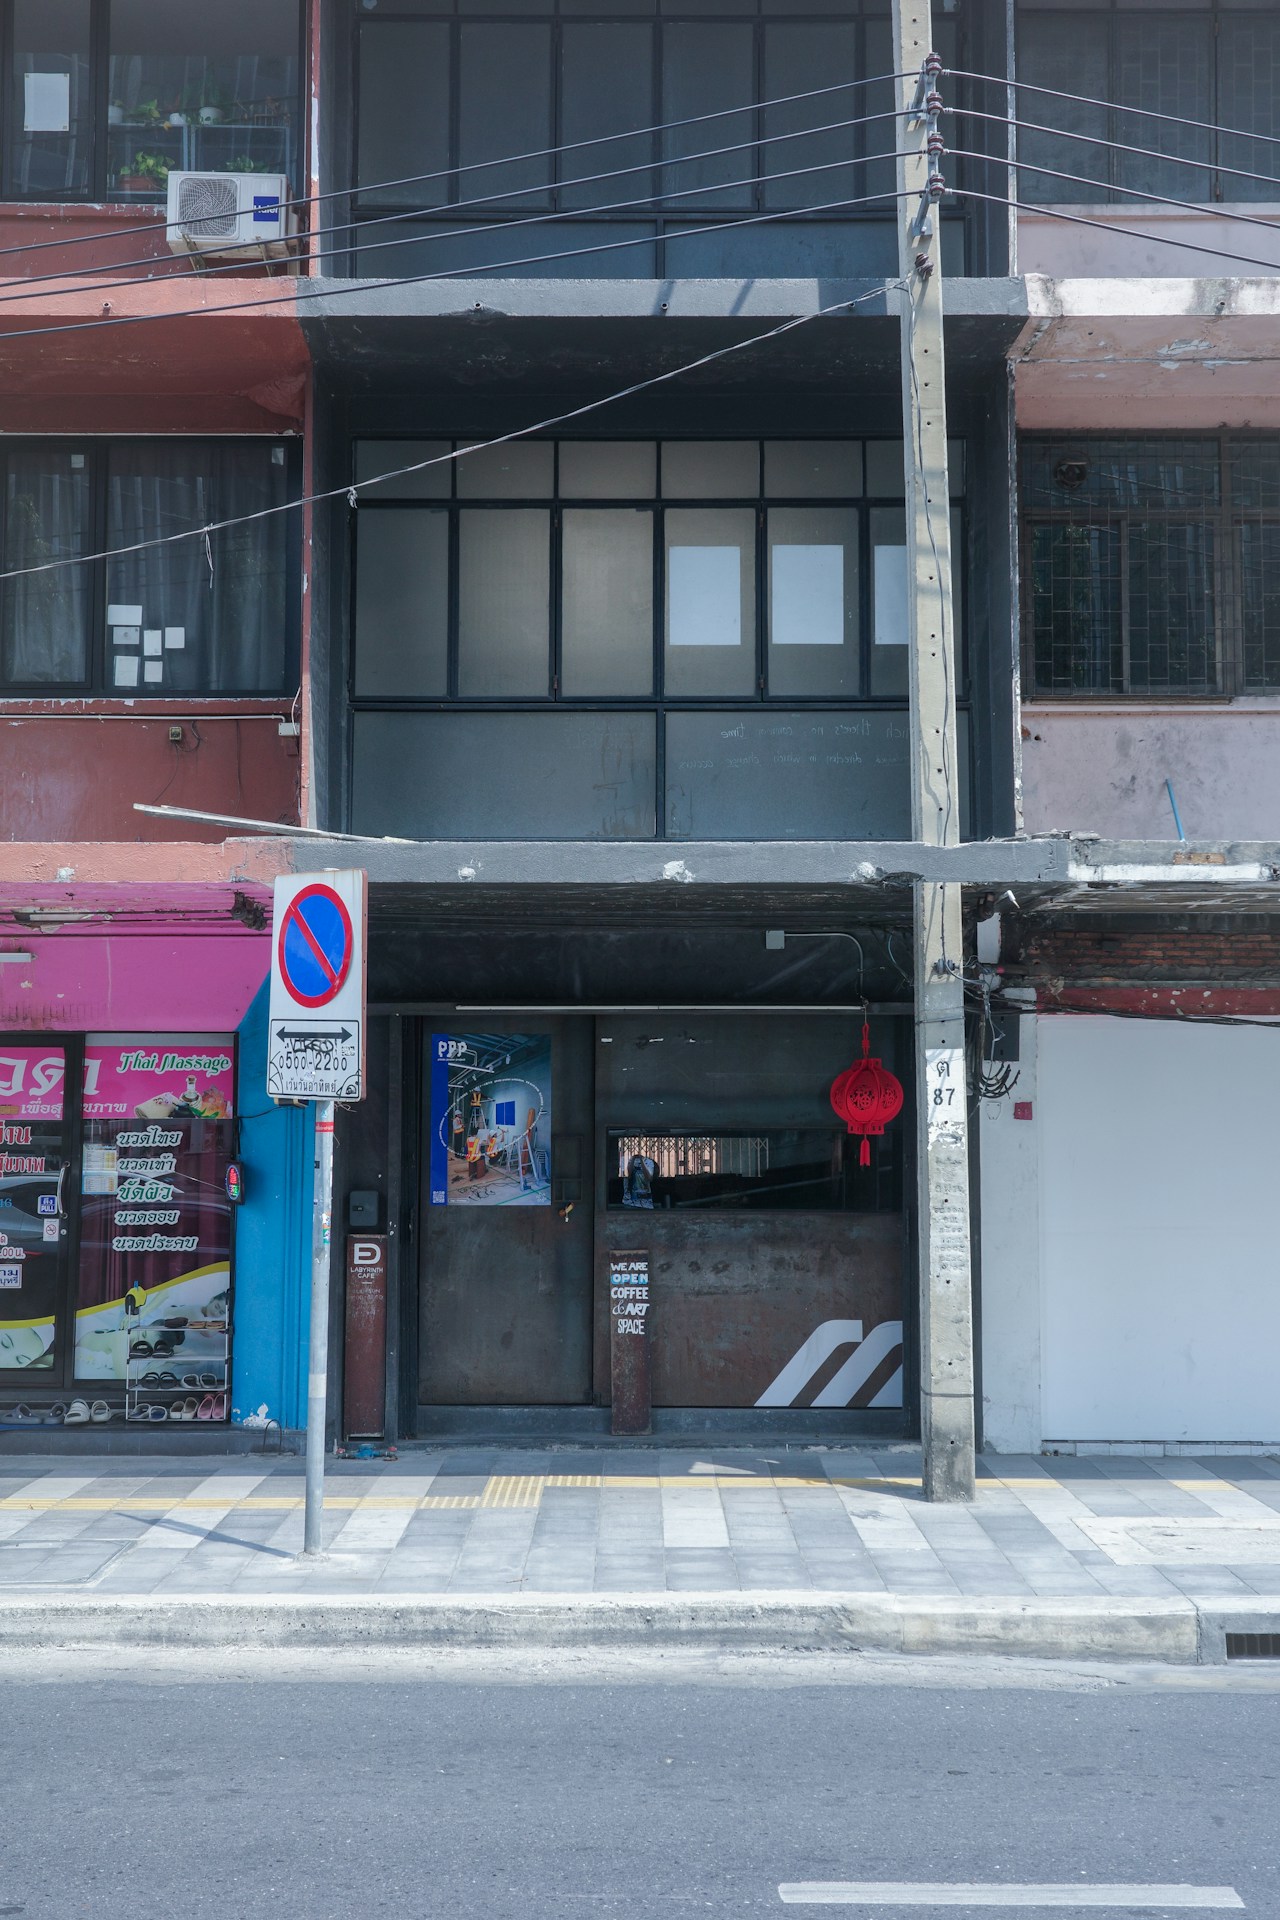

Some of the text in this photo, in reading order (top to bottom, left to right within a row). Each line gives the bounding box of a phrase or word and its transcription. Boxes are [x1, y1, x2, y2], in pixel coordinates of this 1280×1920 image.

[116, 1051, 232, 1076] Thai Massage
[933, 1088, 956, 1106] 87
[116, 1126, 181, 1147] นวดไทย
[350, 1266, 384, 1274] LABYRINTH
[610, 1262, 649, 1272] WE ARE
[611, 1273, 649, 1284] OPEN
[610, 1286, 649, 1300] COFFEE
[617, 1319, 646, 1336] SPACE
